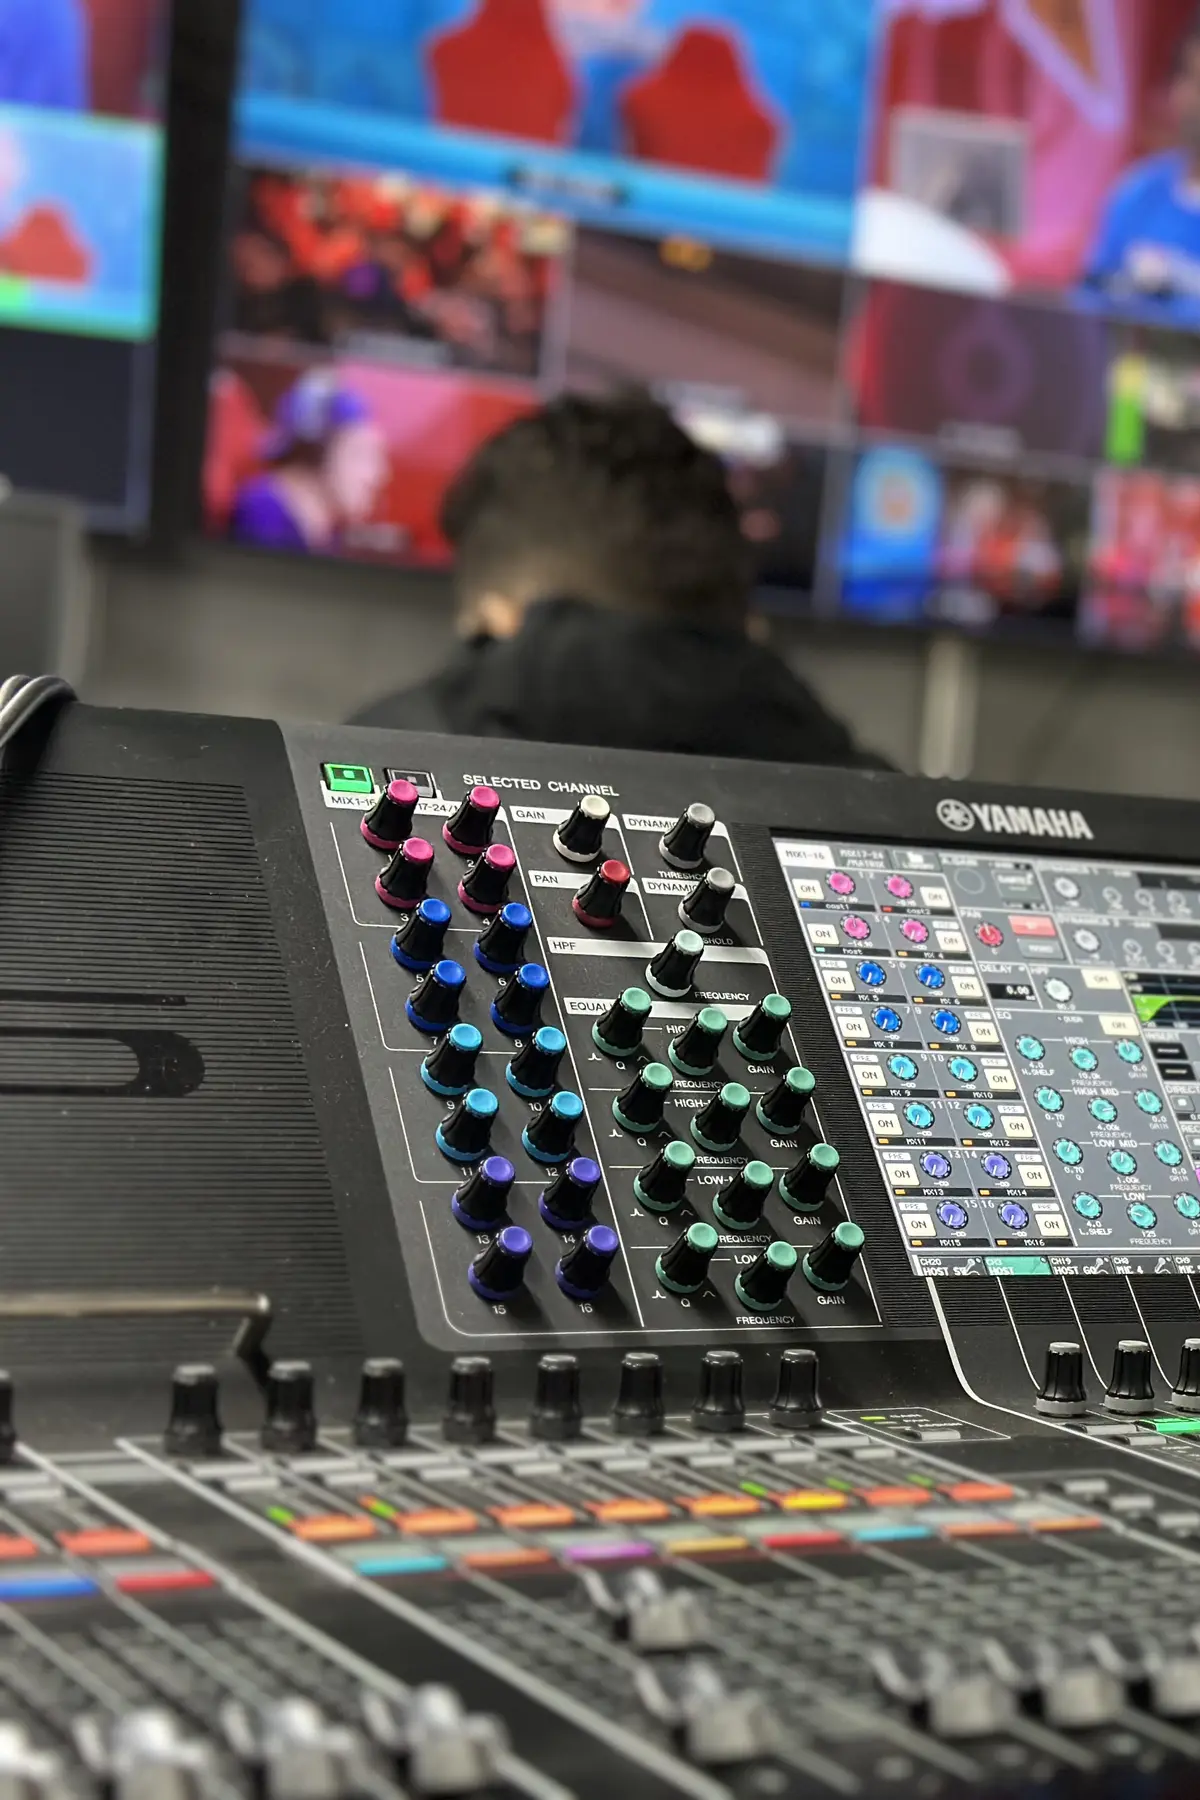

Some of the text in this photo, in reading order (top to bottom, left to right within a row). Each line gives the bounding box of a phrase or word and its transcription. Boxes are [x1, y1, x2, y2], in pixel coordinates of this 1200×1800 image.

[463, 774, 620, 797] SELECTED CHANNEL
[516, 810, 546, 819] GAIN
[629, 818, 677, 829] DYNAMIC
[970, 803, 1094, 840] YAMAHA
[466, 859, 475, 868] 2
[535, 875, 559, 884] PAN
[648, 882, 697, 893] DYNAMIC
[400, 912, 409, 922] 3
[482, 917, 490, 926] 4
[815, 930, 831, 938] ON
[553, 942, 577, 950] HPF
[980, 964, 1012, 973] DELAY
[416, 974, 424, 983] 5
[498, 977, 507, 986] 6
[831, 976, 846, 984] ON
[960, 982, 975, 990] ON
[695, 992, 749, 1001] FREQUENCY
[846, 1023, 862, 1031] ON
[976, 1028, 991, 1036] ON
[430, 1036, 438, 1045] 7
[514, 1039, 523, 1048] 8
[616, 1061, 626, 1070] Q
[748, 1065, 774, 1073] GAIN
[862, 1071, 878, 1079] ON
[992, 1075, 1008, 1083] ON
[673, 1080, 725, 1090] REQUENCY
[1073, 1087, 1097, 1095] HIGH
[446, 1100, 455, 1110] 9
[528, 1102, 542, 1111] 10
[878, 1120, 893, 1128] ON
[638, 1138, 647, 1146] Q
[770, 1140, 797, 1148] GAIN
[1119, 1140, 1137, 1148] MID
[696, 1156, 749, 1165] REQUENCY
[461, 1167, 472, 1176] 11
[546, 1168, 558, 1176] 12
[895, 1170, 910, 1178] ON
[965, 1200, 978, 1208] 15
[659, 1217, 668, 1226] Q
[793, 1217, 821, 1225] GAIN
[1044, 1221, 1060, 1229] ON
[476, 1235, 490, 1244] 13
[562, 1234, 575, 1243] 14
[924, 1267, 948, 1275] HOST
[990, 1267, 1014, 1275] HOST
[1178, 1266, 1195, 1274] MIC
[681, 1299, 690, 1308] Q
[817, 1296, 845, 1304] GAIN
[492, 1305, 506, 1314] 15
[579, 1303, 593, 1313] 16
[736, 1316, 795, 1324] FREQUENCY
